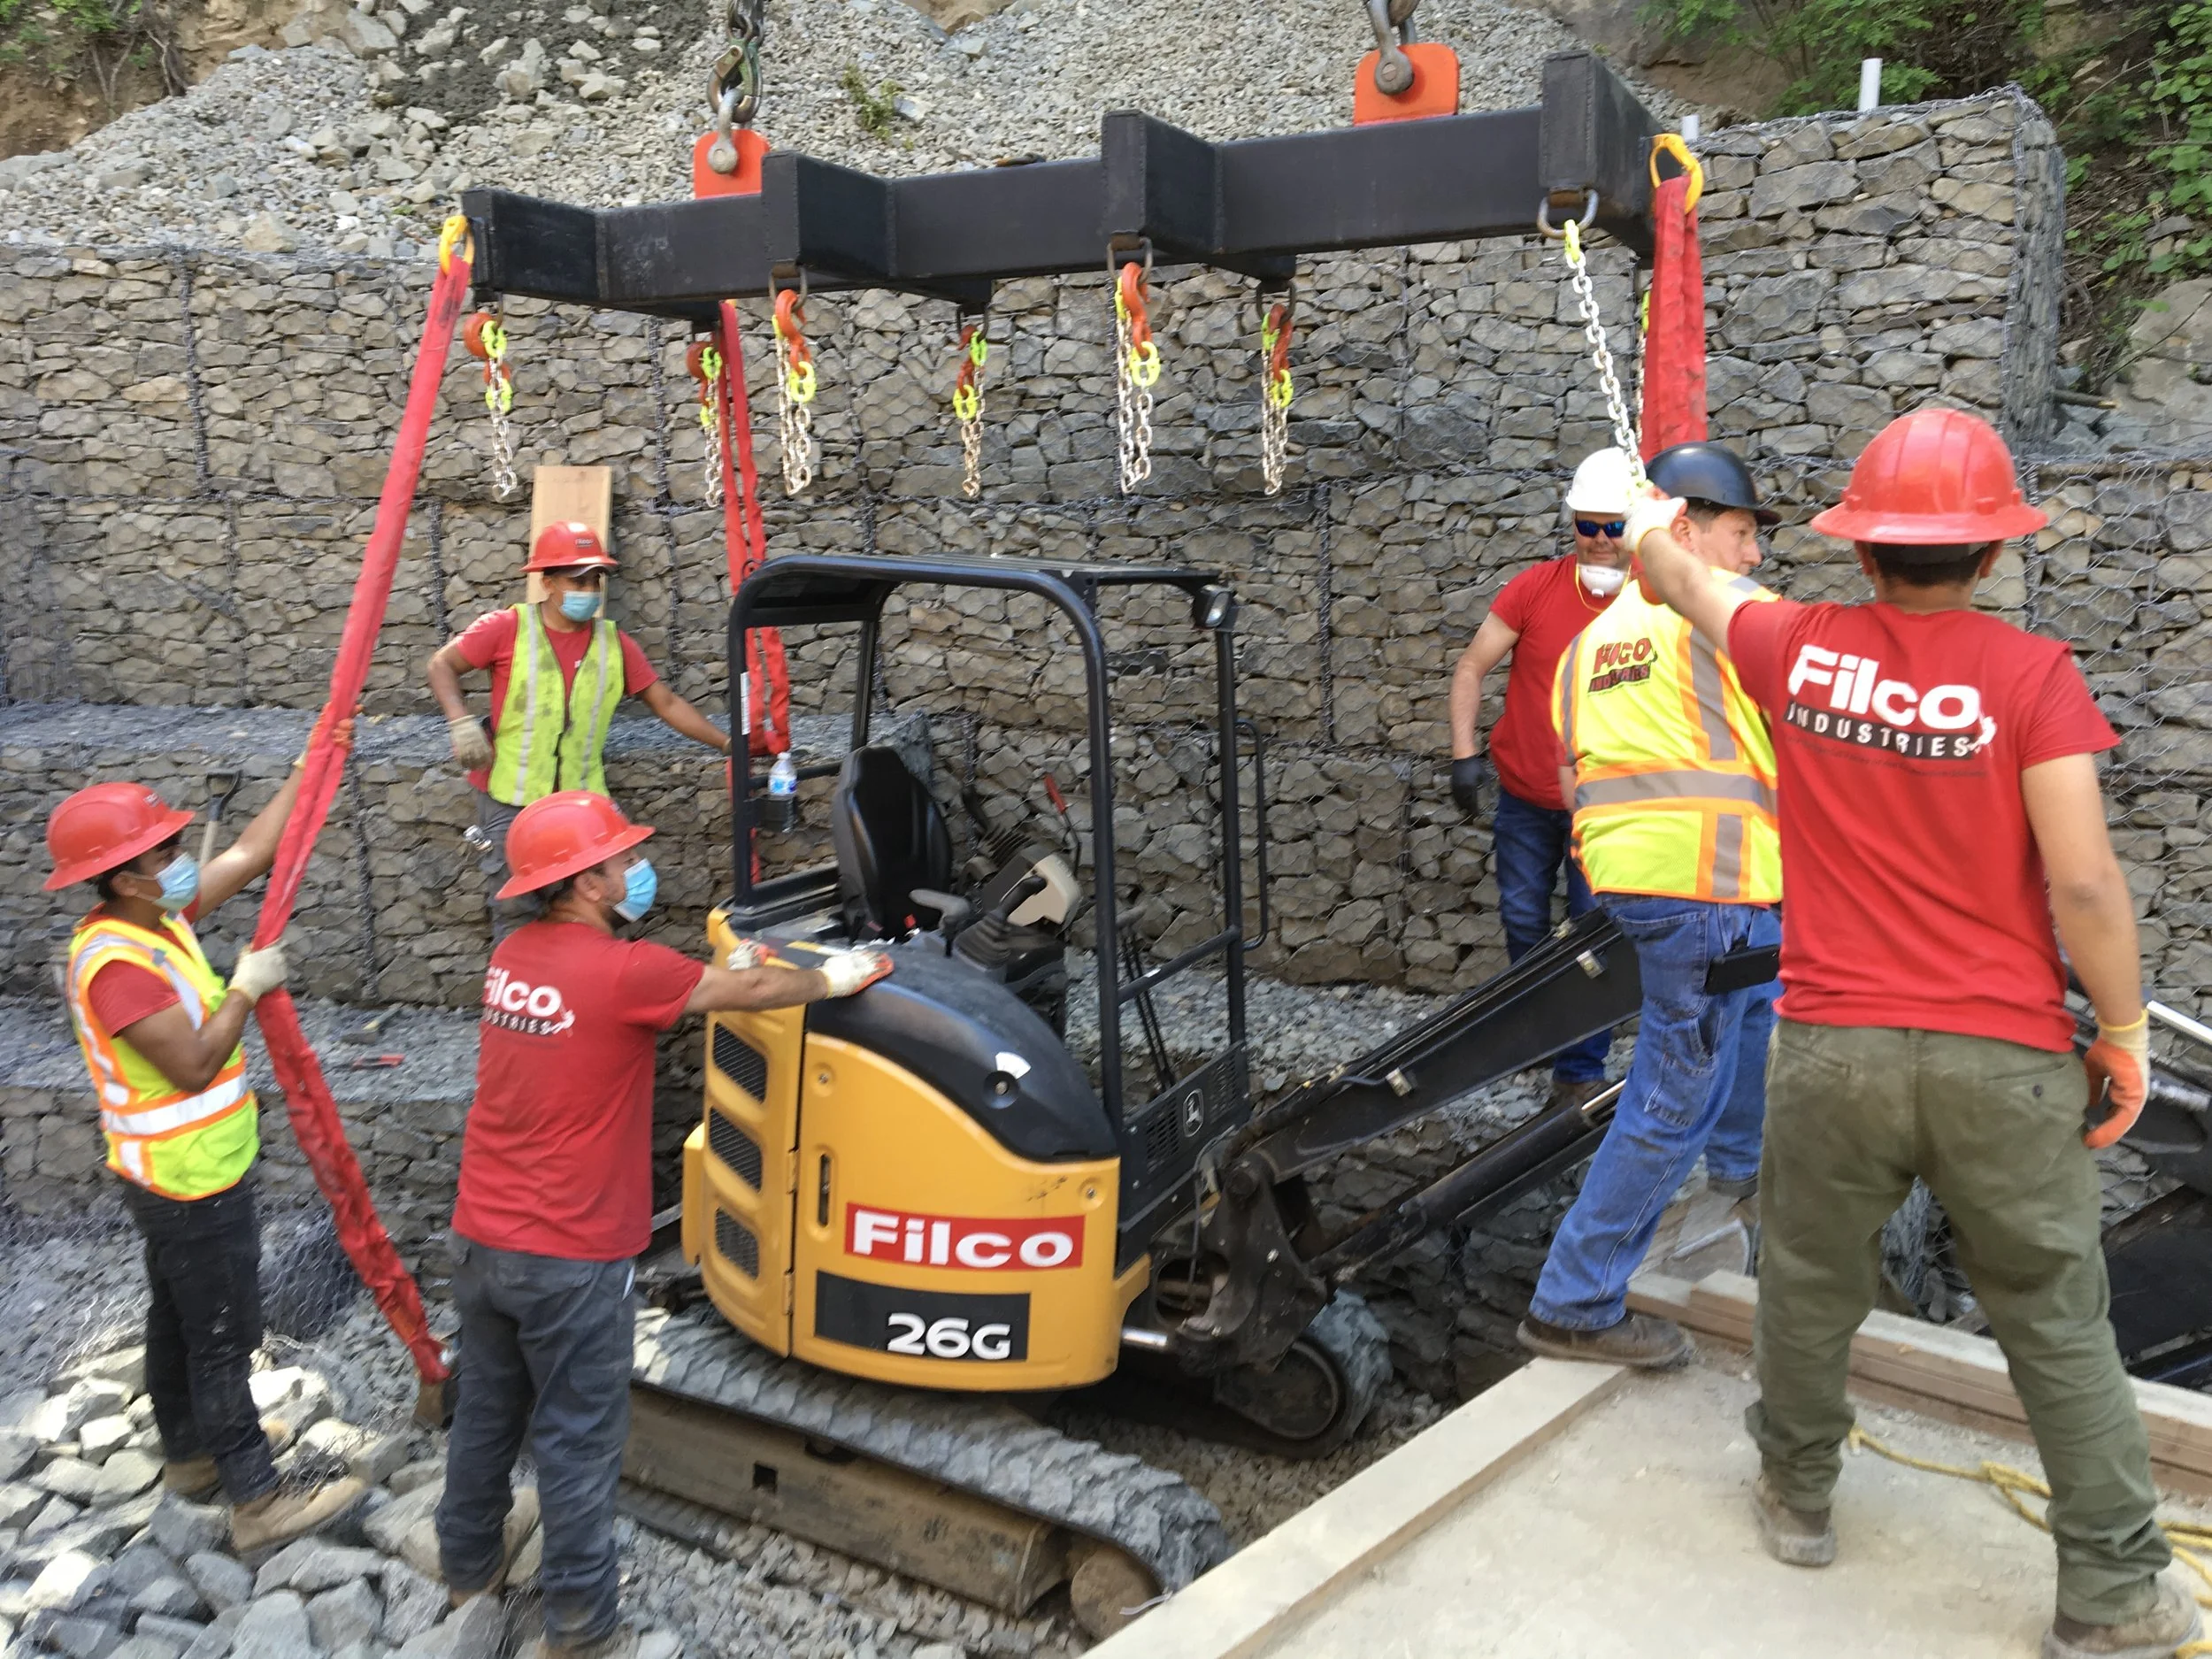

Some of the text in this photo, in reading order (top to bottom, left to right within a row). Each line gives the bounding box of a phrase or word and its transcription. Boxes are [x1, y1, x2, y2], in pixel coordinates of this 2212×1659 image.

[1788, 644, 1981, 730] Filco
[1786, 703, 1970, 757] INDUSTRIES
[853, 1209, 1073, 1268] Filco
[887, 1312, 1011, 1360] 26G
